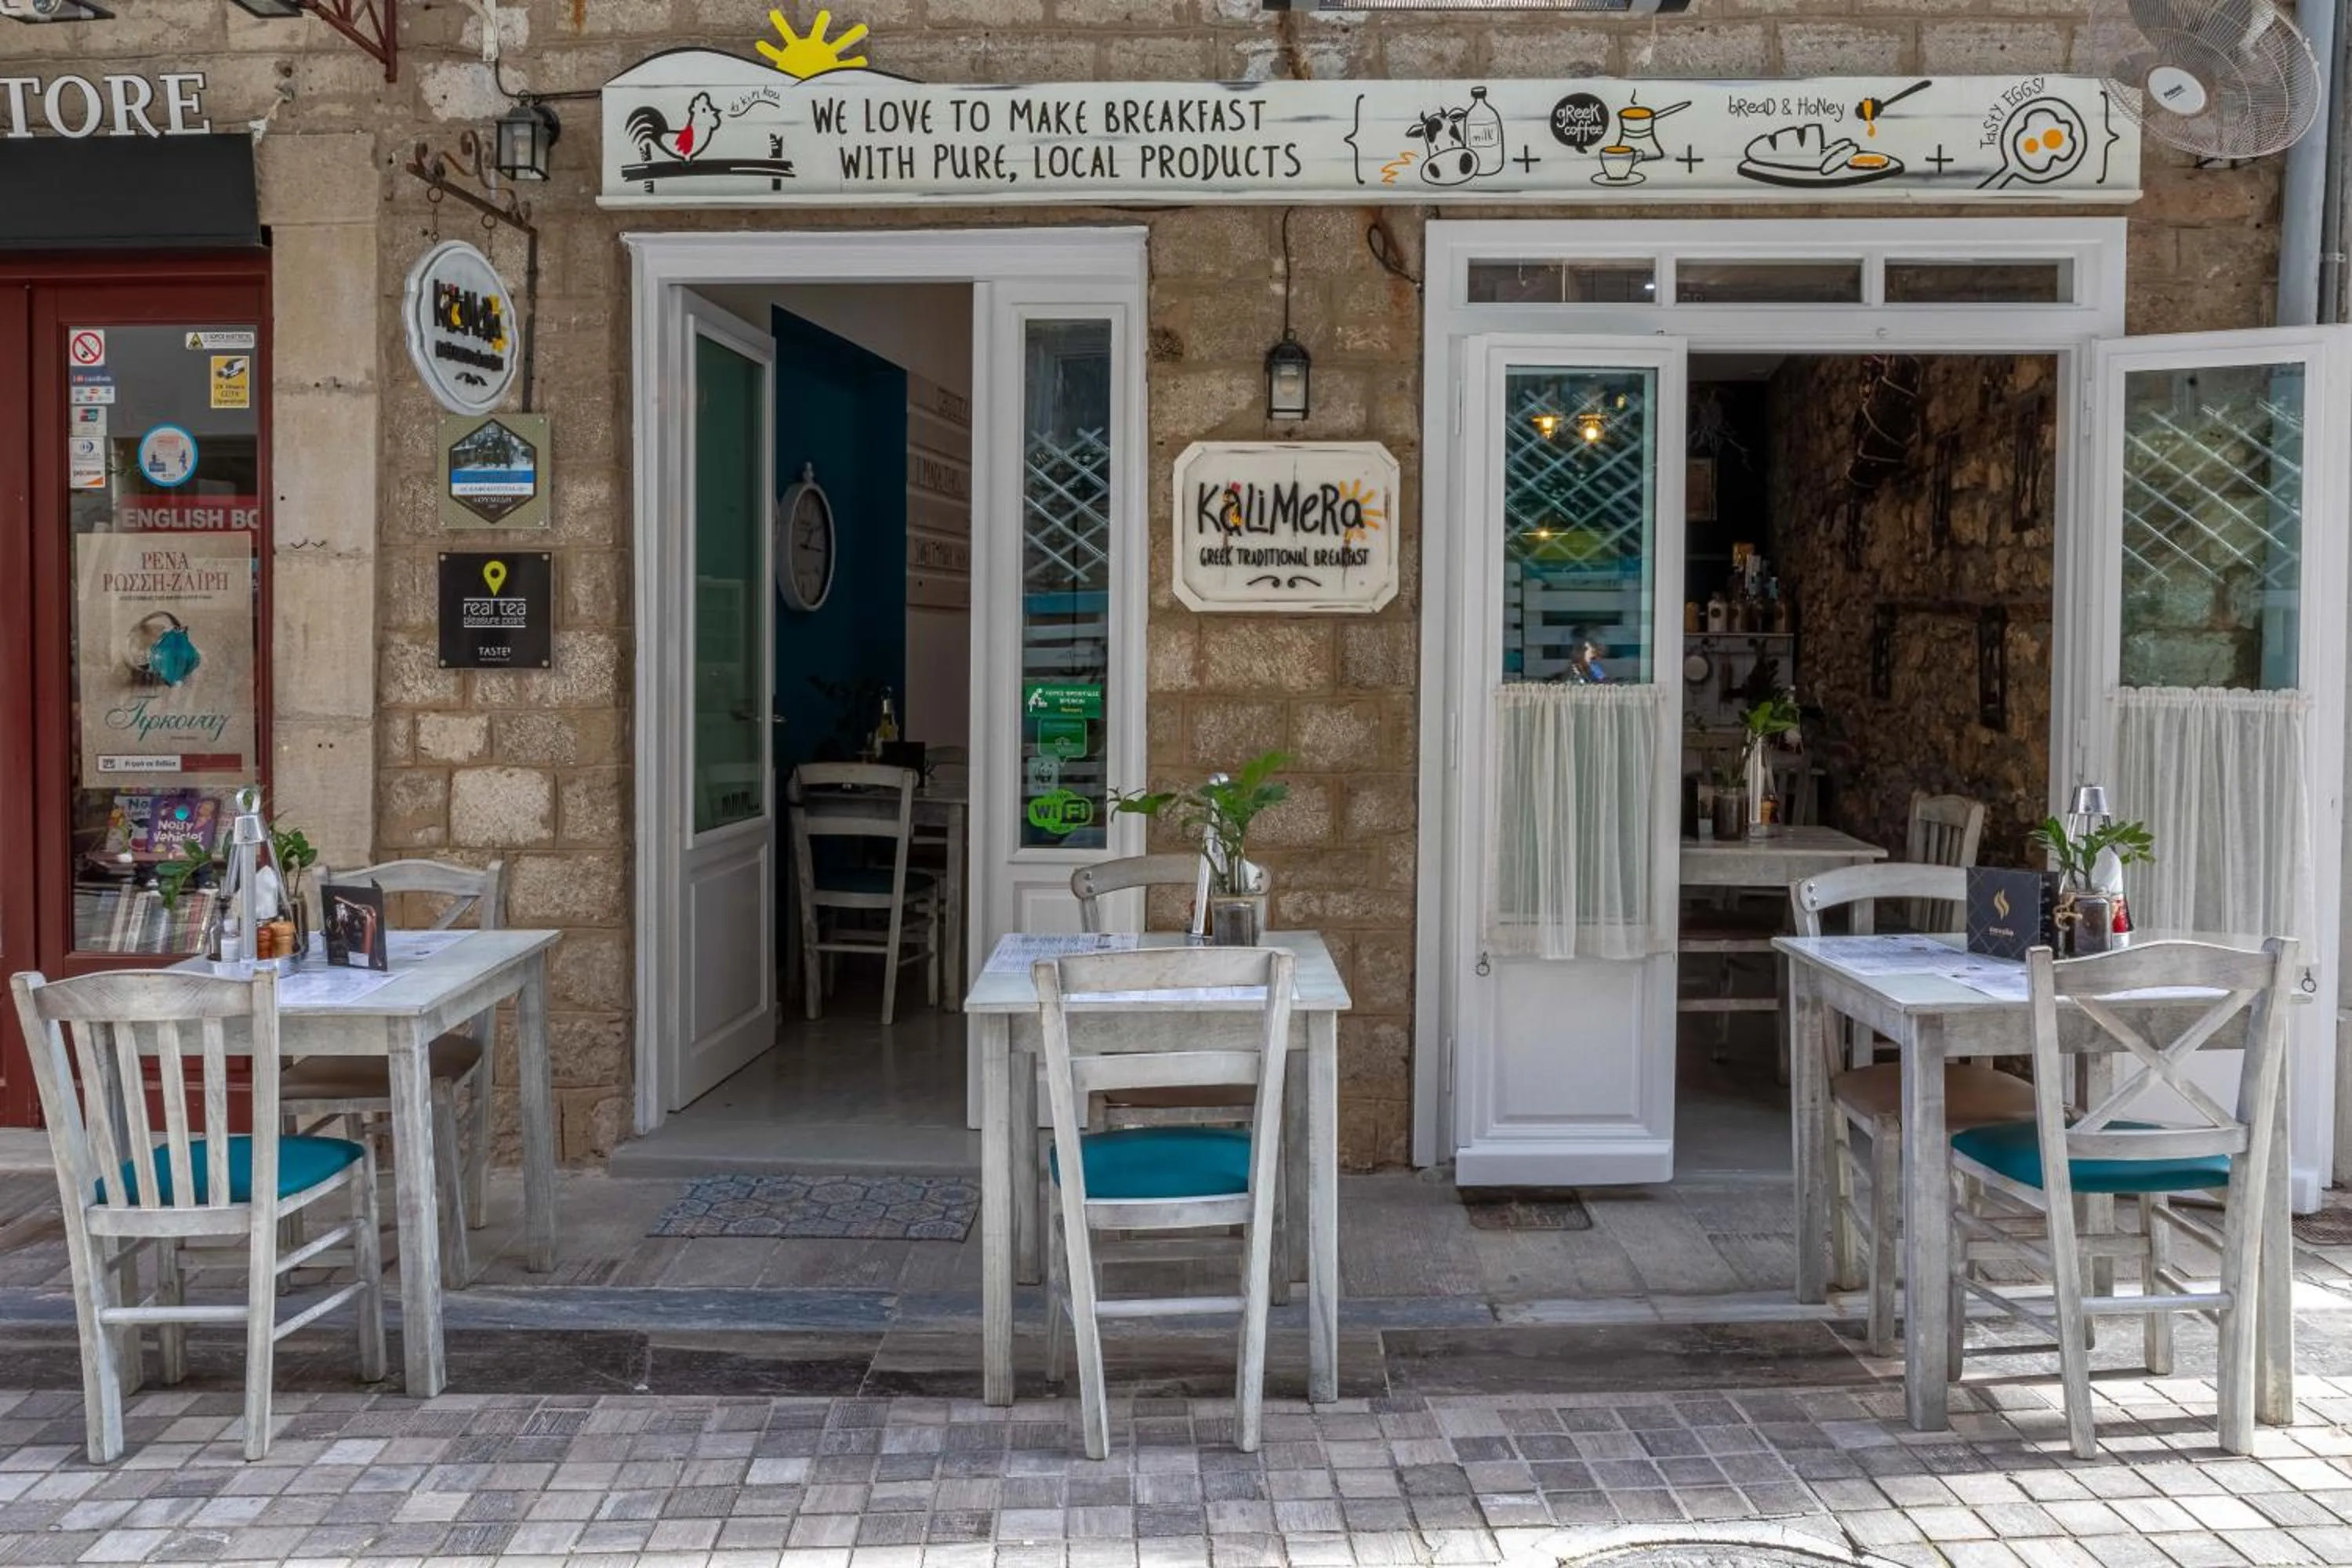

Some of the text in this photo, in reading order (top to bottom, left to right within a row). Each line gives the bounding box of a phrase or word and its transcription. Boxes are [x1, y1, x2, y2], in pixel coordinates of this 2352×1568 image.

[0, 72, 212, 139] TORE
[811, 99, 1267, 134] WE LOVE TO MAKE BREAKFAST
[1780, 98, 1792, 116] &
[1473, 127, 1494, 142] milk
[1564, 120, 1603, 143] coffee
[840, 143, 1302, 183] WITH PURE, LOCAL PRODUCTS
[122, 508, 223, 530] ENGLISH
[141, 551, 189, 571] ΡΕΝΑ
[1199, 546, 1370, 568] GREEK TRADITIONAL BREAKFAST
[463, 601, 527, 616] real tea
[128, 798, 151, 810] No
